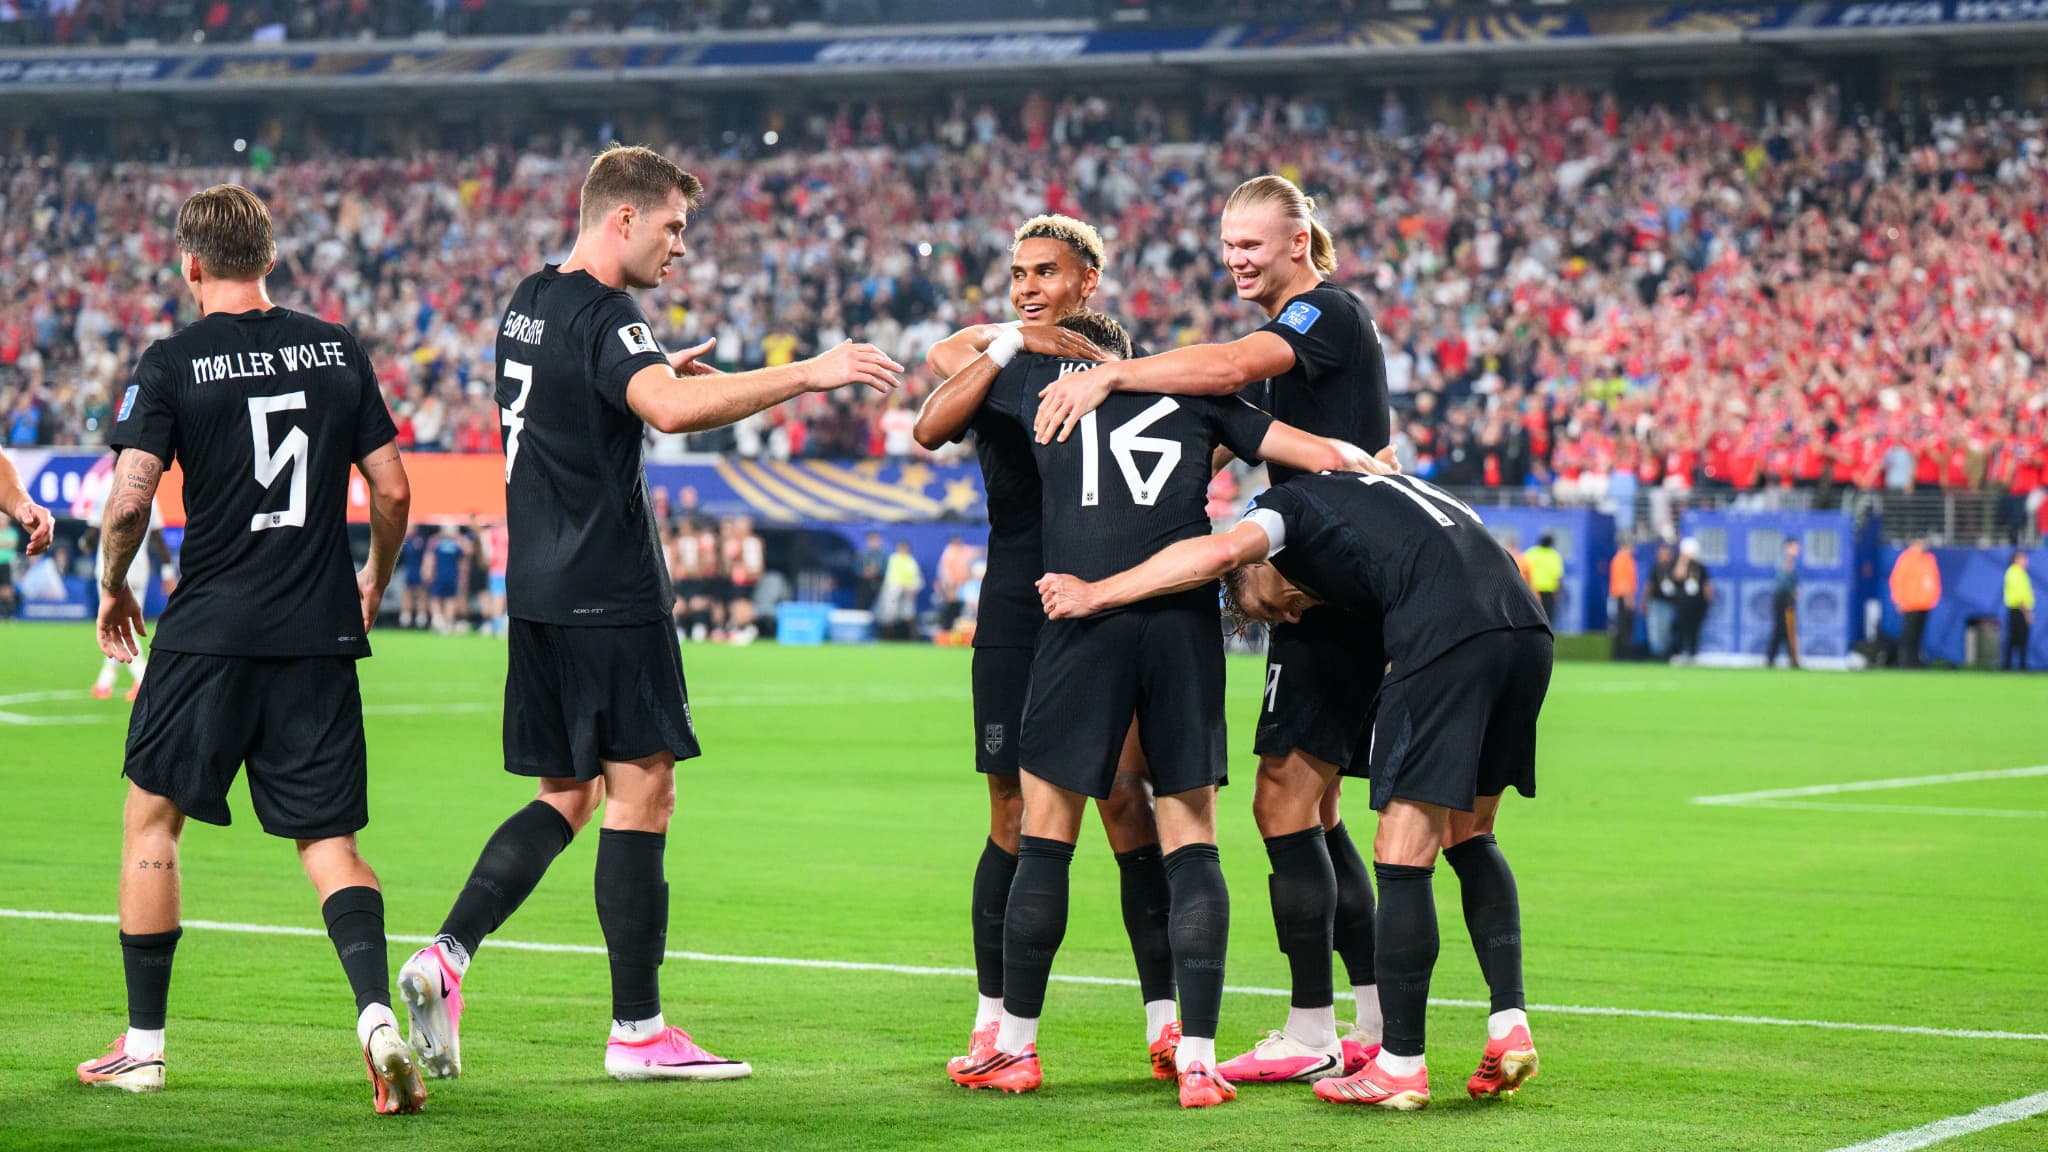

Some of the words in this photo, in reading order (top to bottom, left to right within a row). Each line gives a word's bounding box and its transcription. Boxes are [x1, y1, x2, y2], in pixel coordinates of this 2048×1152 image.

[191, 352, 277, 385] MØLLER
[278, 341, 347, 373] WOLFE
[247, 390, 309, 532] 5
[1080, 395, 1182, 507] 16
[1264, 662, 1282, 713] 9
